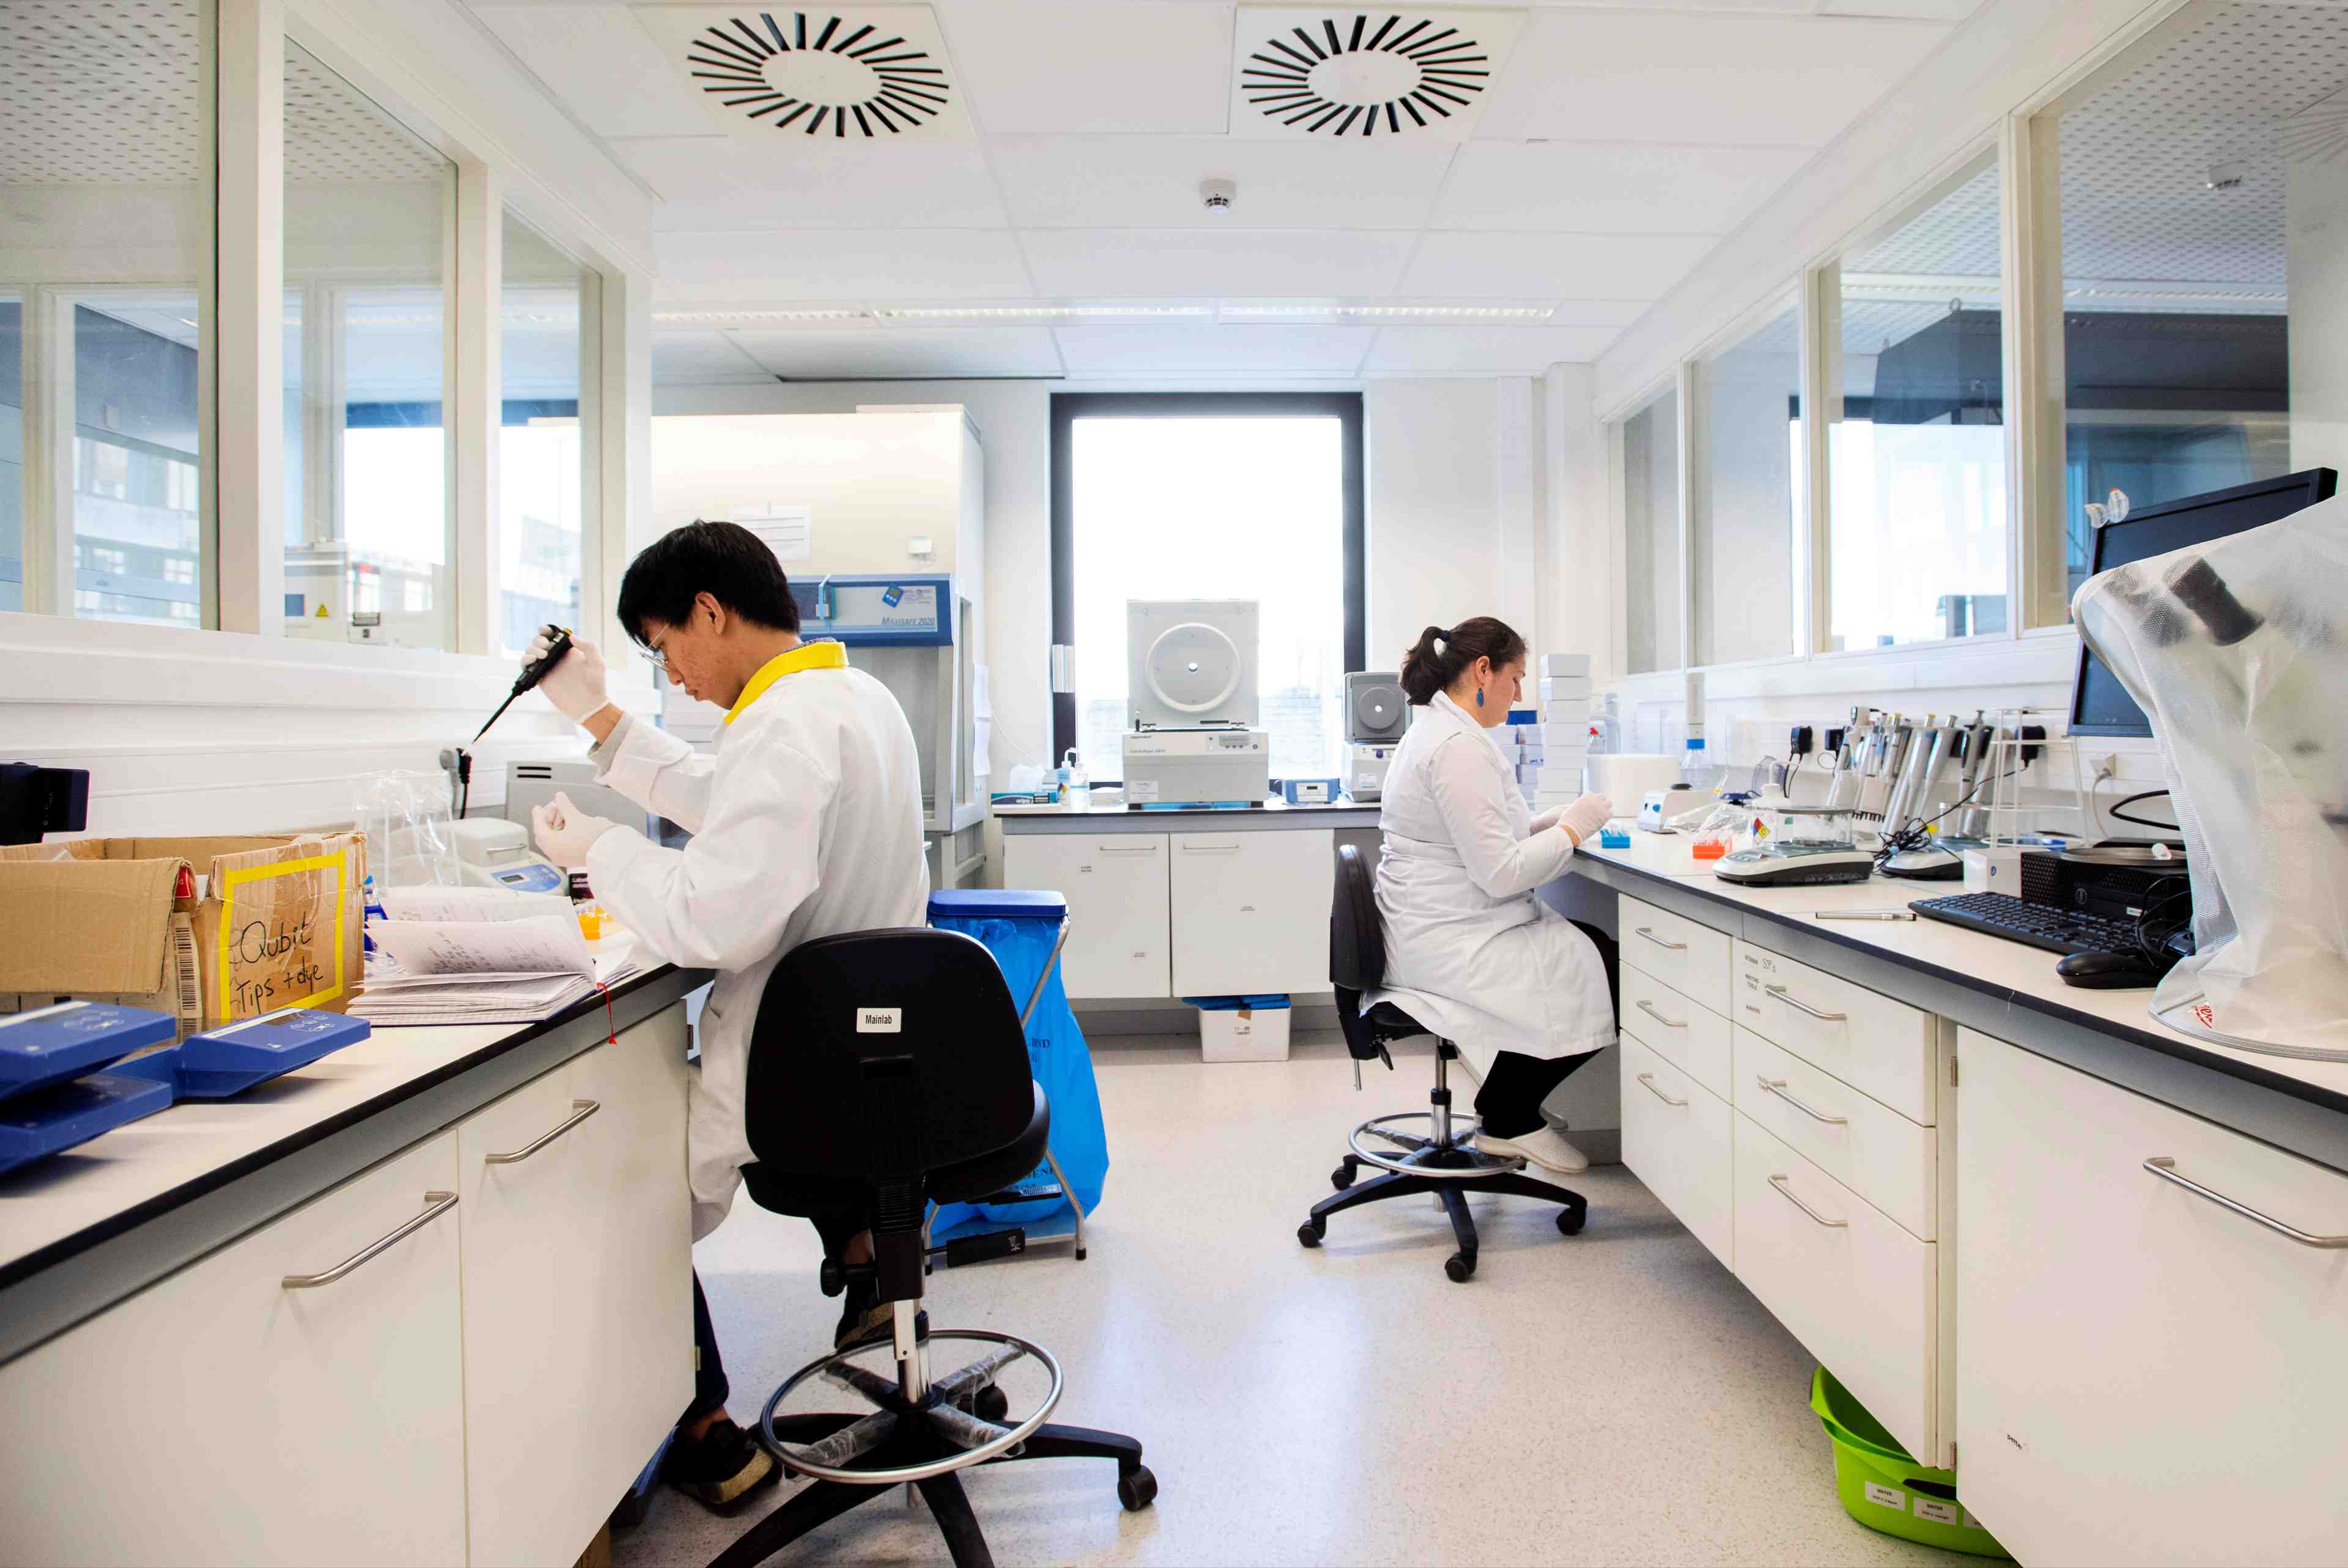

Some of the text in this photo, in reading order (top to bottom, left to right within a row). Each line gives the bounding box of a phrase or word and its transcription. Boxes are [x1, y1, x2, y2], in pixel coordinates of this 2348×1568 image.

[240, 910, 311, 963] Qubit
[236, 978, 275, 1015] Tips
[865, 1014, 893, 1025] Mainlab
